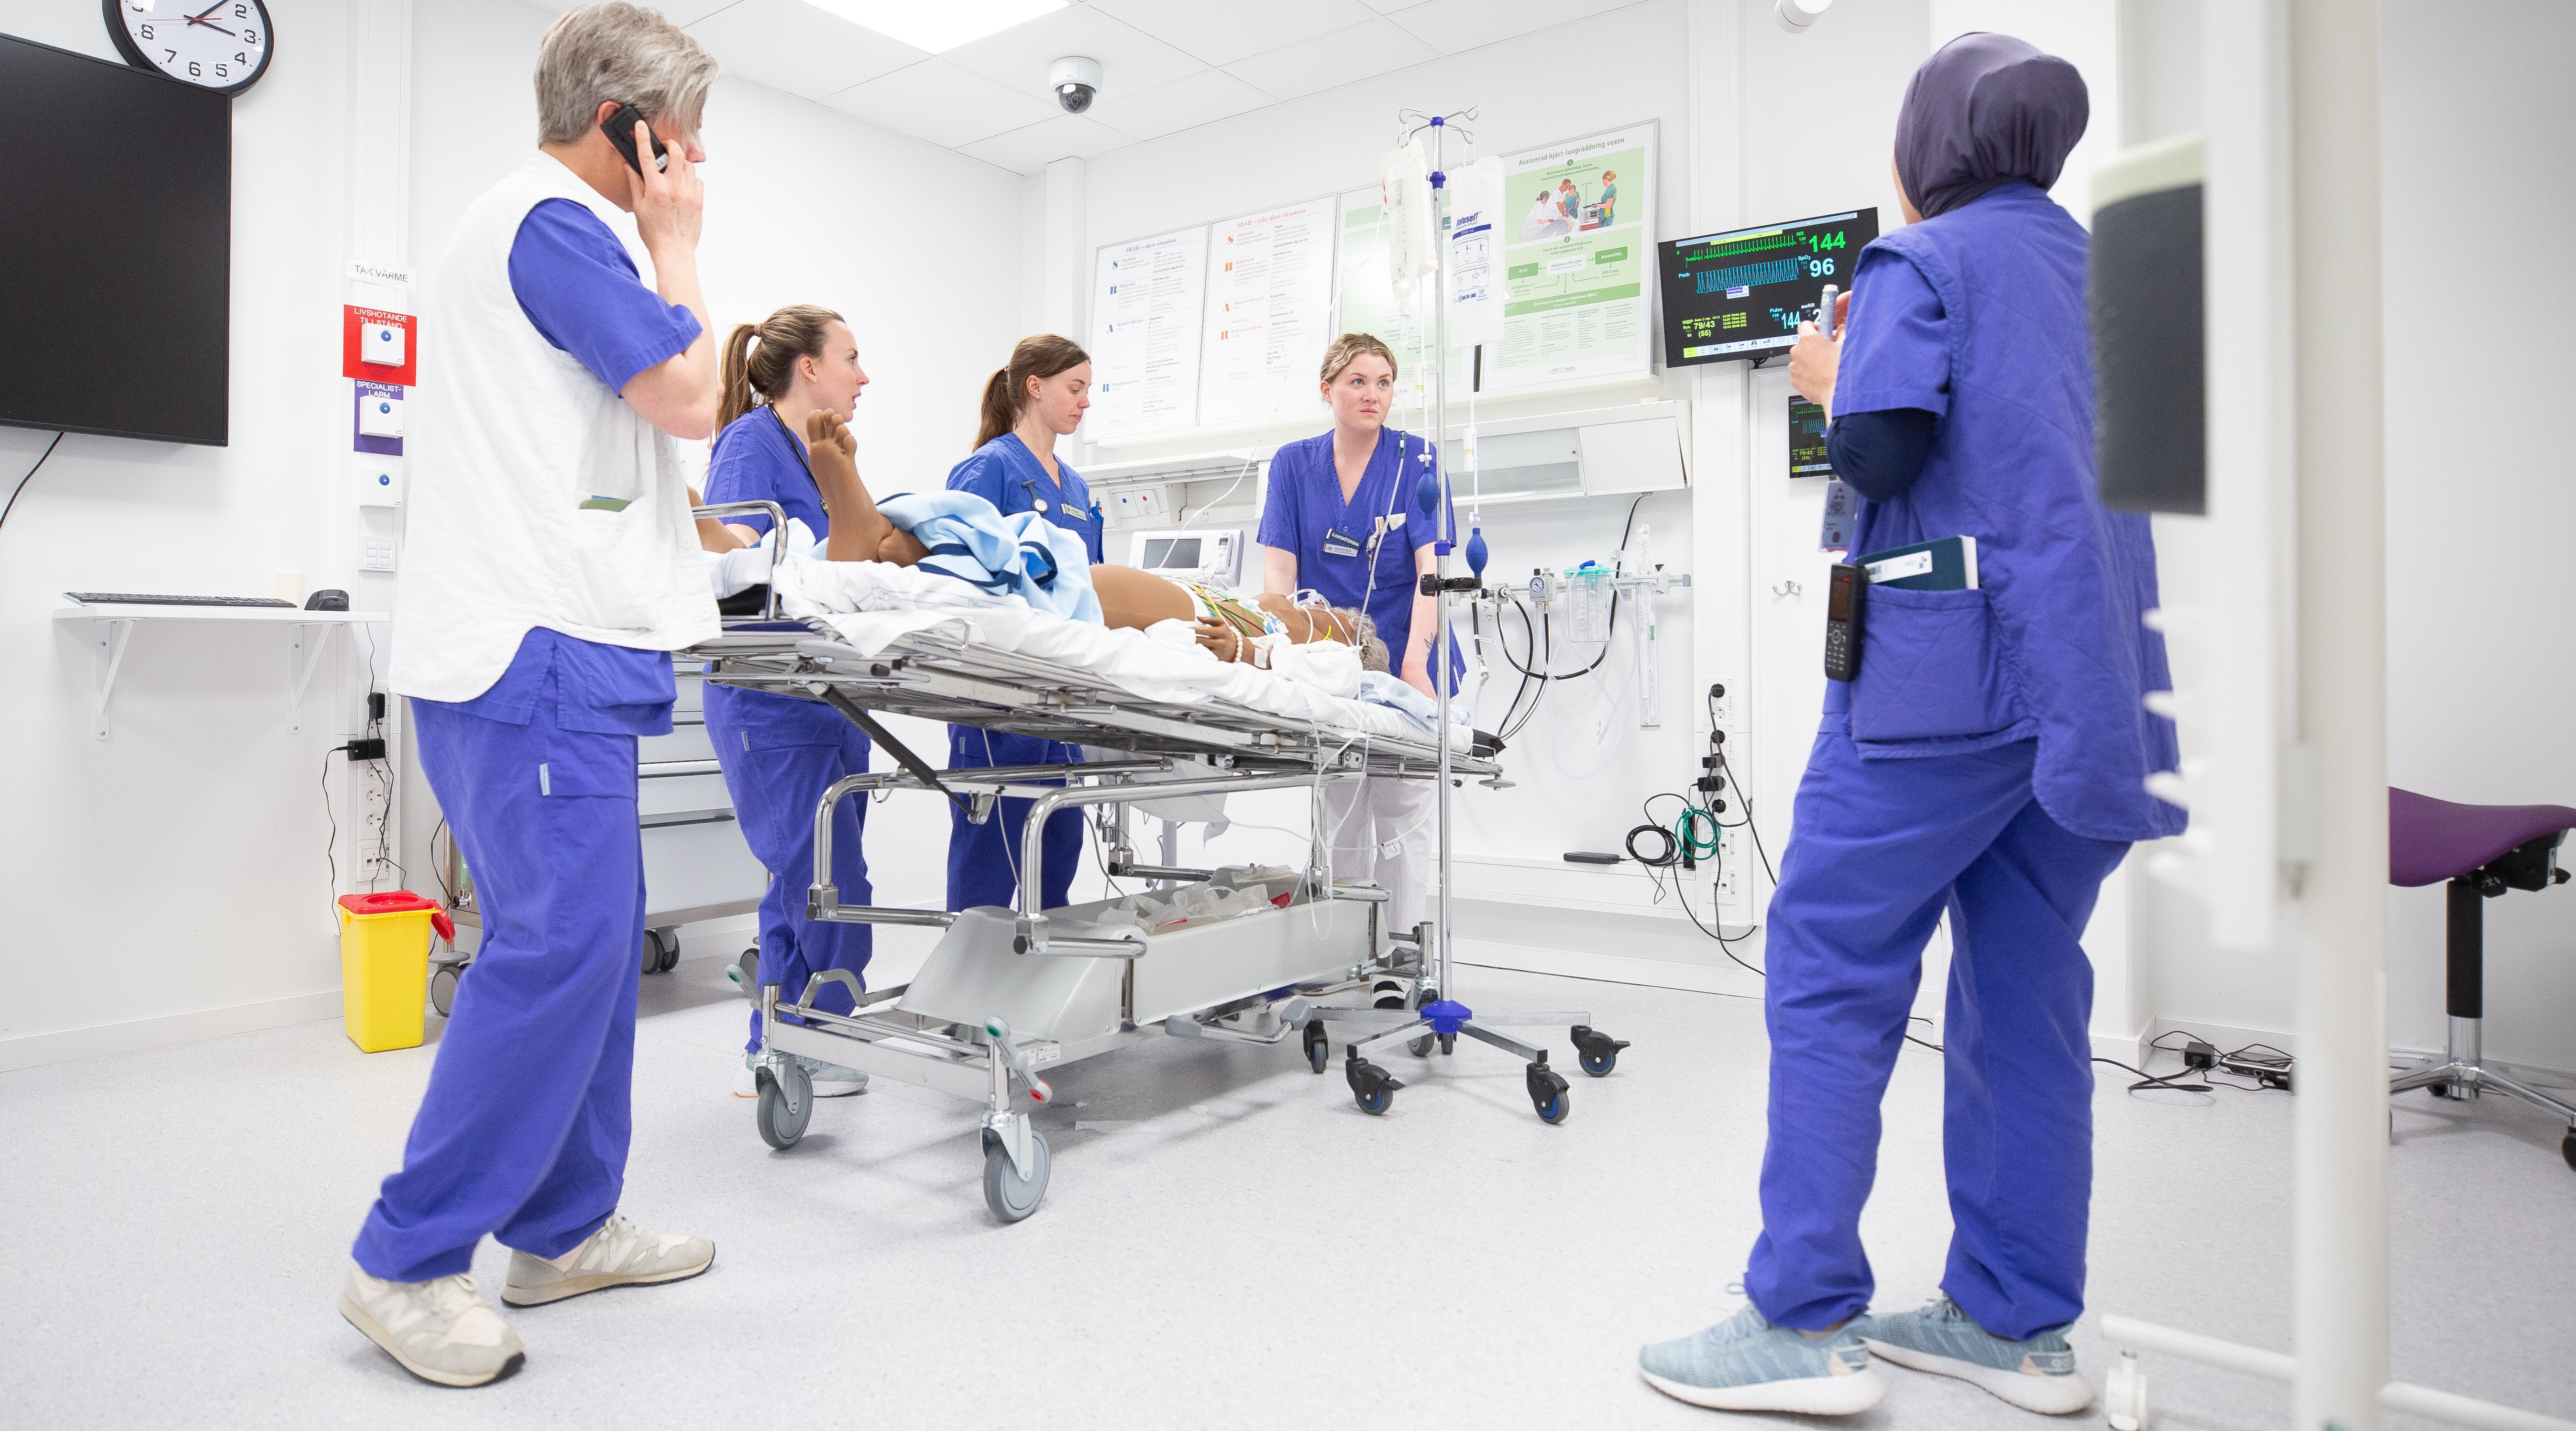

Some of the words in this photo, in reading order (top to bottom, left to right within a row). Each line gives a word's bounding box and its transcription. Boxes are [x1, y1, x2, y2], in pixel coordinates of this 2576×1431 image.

[235, 4, 247, 19] 2
[142, 24, 154, 40] 8
[244, 29, 256, 44] 3
[165, 48, 176, 63] 7
[234, 52, 246, 66] 4
[189, 61, 201, 77] 6
[215, 64, 227, 77] 5
[1519, 154, 1547, 166] Avancerad
[1549, 143, 1605, 160] hjärt-lungräddning
[1607, 138, 1625, 146] vuxen
[1236, 220, 1252, 228] SBAR
[1282, 207, 1305, 218] situation
[1125, 245, 1140, 253] SBAR
[1156, 237, 1177, 246] situation
[1227, 234, 1233, 245] S
[1809, 231, 1846, 253] 144
[354, 264, 373, 275] TAK
[375, 269, 408, 282] VÄRME
[1225, 262, 1233, 272] B
[1810, 258, 1835, 277] 96
[1110, 285, 1117, 295] B
[354, 307, 407, 322] LIVSHOTANDE
[1781, 311, 1801, 330] 144
[360, 316, 402, 329] TILLSTÅND
[1694, 320, 1715, 330] 79/43
[1698, 329, 1711, 338] (55)
[356, 381, 402, 392] SPECIALIST-
[368, 390, 390, 398] LARM
